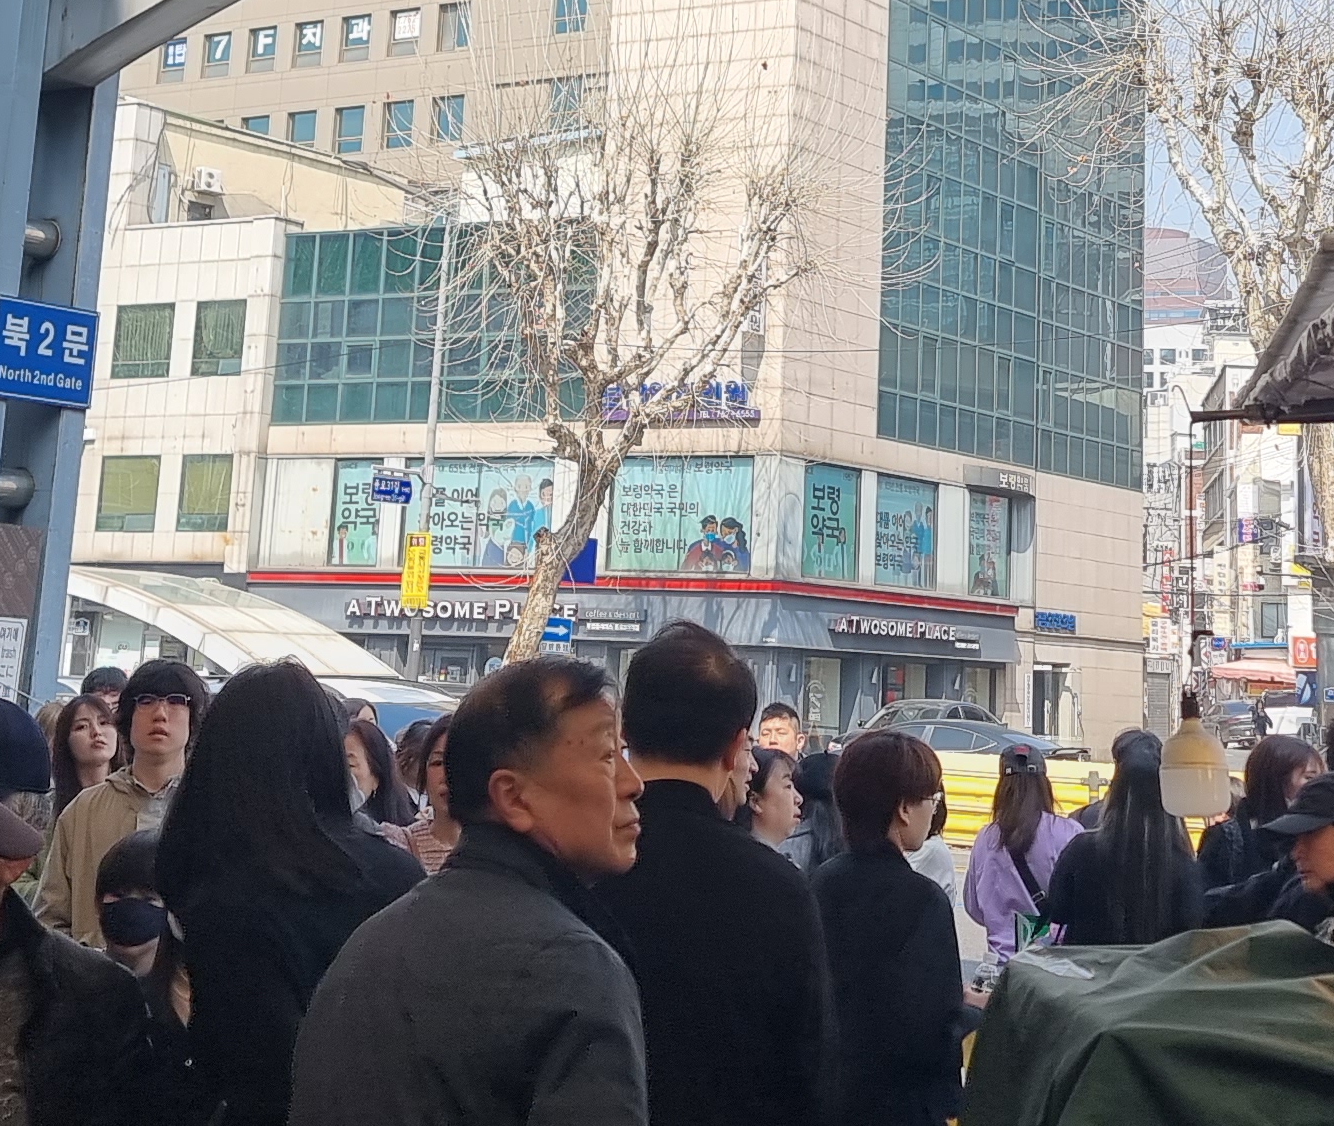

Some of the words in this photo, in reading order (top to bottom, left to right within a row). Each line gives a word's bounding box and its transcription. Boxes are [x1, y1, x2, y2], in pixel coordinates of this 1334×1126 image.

[33, 370, 54, 386] 2nd
[56, 373, 83, 391] Gate
[621, 483, 665, 499] 보령약국
[666, 483, 679, 498] 은
[811, 482, 841, 517] 보령
[341, 507, 377, 531] 약국
[620, 501, 664, 518] 대한민국
[666, 501, 700, 518] 국민의
[425, 513, 474, 531] 아오는
[431, 535, 473, 555] 령약국
[632, 538, 688, 555] 함께합니다
[346, 601, 360, 617] A
[494, 598, 578, 622] PLCE
[0, 626, 20, 642] 여기에
[837, 616, 848, 633] A
[850, 615, 914, 638] TWOSOME
[916, 620, 957, 641] PLACE
[0, 645, 17, 659] trash
